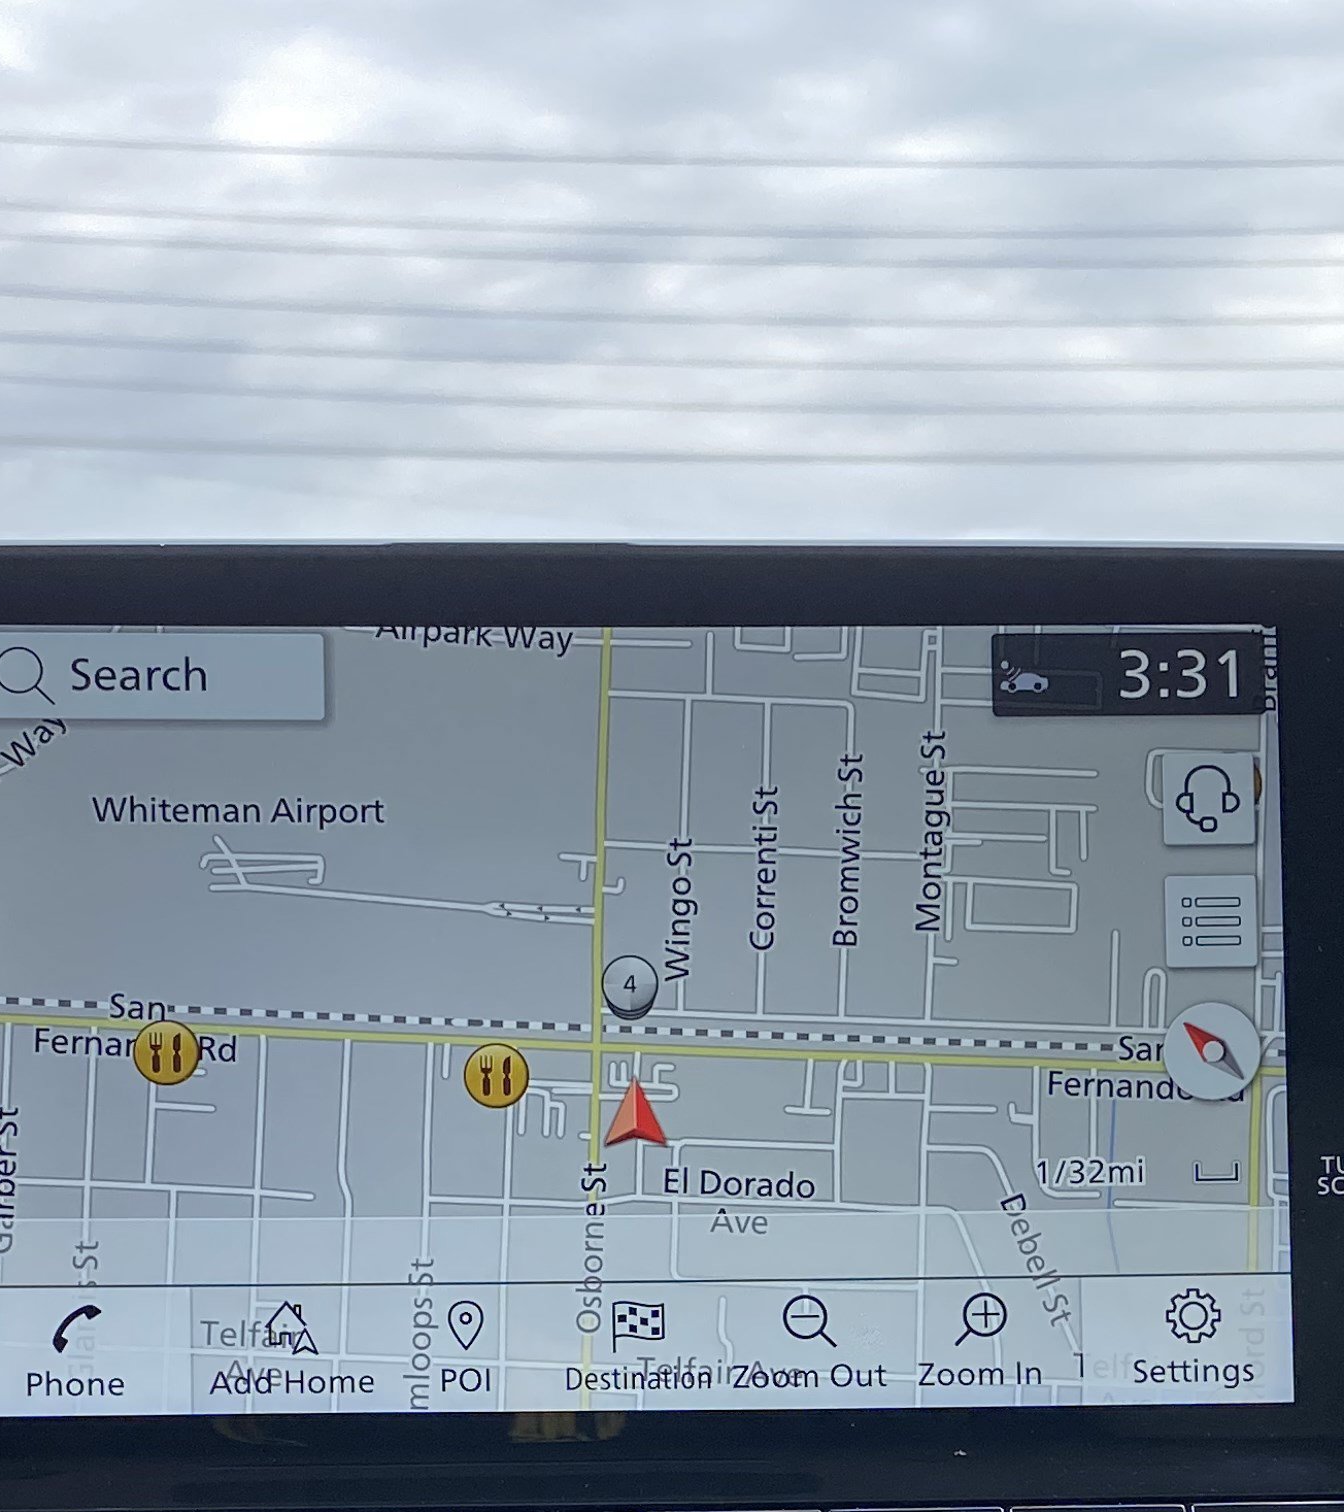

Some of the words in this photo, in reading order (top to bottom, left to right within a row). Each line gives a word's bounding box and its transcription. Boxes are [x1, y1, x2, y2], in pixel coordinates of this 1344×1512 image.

[505, 626, 574, 658] Way
[70, 656, 207, 692] Search
[1119, 649, 1238, 699] 3:31
[921, 730, 946, 760] St
[838, 754, 863, 783] St
[92, 796, 261, 824] Whiteman
[271, 798, 385, 830] Airport
[753, 786, 778, 815] St
[667, 838, 693, 867] St
[915, 769, 950, 933] Montague
[833, 795, 862, 947] Bromwich
[749, 826, 777, 950] Correnti
[665, 876, 698, 982] Wingo
[623, 974, 637, 993] 4
[109, 993, 165, 1021] San
[198, 1036, 237, 1063] Rd
[581, 1163, 606, 1193] St
[663, 1168, 688, 1194] El
[700, 1170, 816, 1199] Dorado
[1036, 1158, 1145, 1185] 1/32mi
[710, 1208, 768, 1235] Ave
[73, 1239, 99, 1270] St
[575, 1202, 606, 1333] Osborne
[408, 1257, 435, 1287] St
[1042, 1294, 1072, 1328] St
[26, 1371, 126, 1397] Phone
[209, 1371, 273, 1395] Add
[285, 1370, 374, 1394] Home
[441, 1368, 491, 1392] POI
[565, 1367, 712, 1391] Destination
[732, 1364, 819, 1389] Zoom
[830, 1363, 887, 1388] Out
[918, 1362, 1004, 1387] Zoom
[1017, 1361, 1042, 1385] In
[1133, 1358, 1255, 1389] Settings
